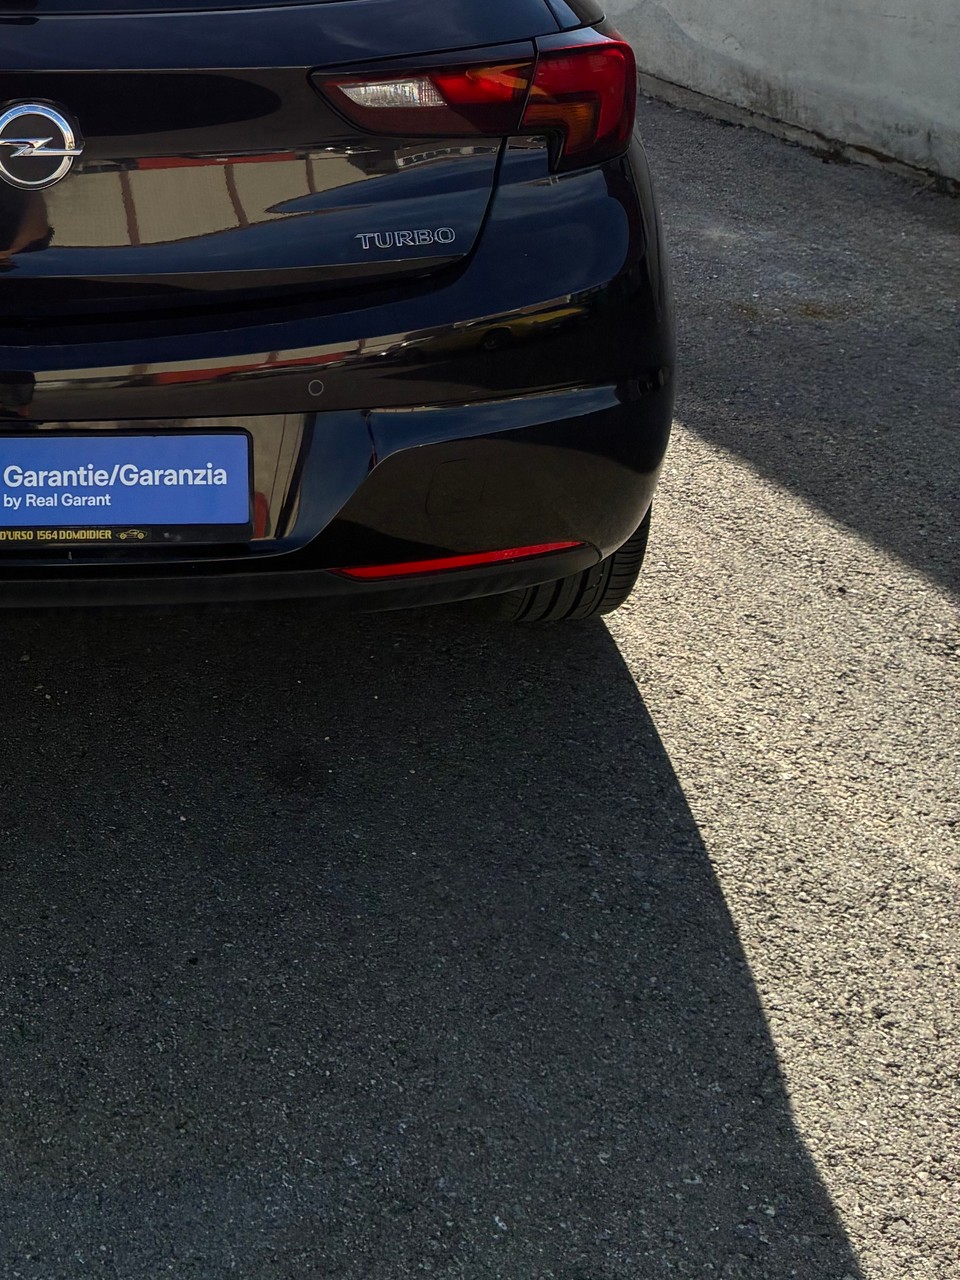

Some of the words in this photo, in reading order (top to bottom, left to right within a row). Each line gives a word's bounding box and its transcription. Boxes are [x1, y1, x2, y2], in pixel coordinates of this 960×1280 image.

[354, 227, 456, 249] TURBO
[3, 463, 228, 488] Garantie/Garanzia
[3, 493, 22, 510] by
[25, 493, 59, 508] Real
[61, 493, 112, 508] Garant
[0, 531, 34, 541] D'URSO
[37, 530, 58, 540] 1564
[59, 530, 112, 540] DOMDIDIER
